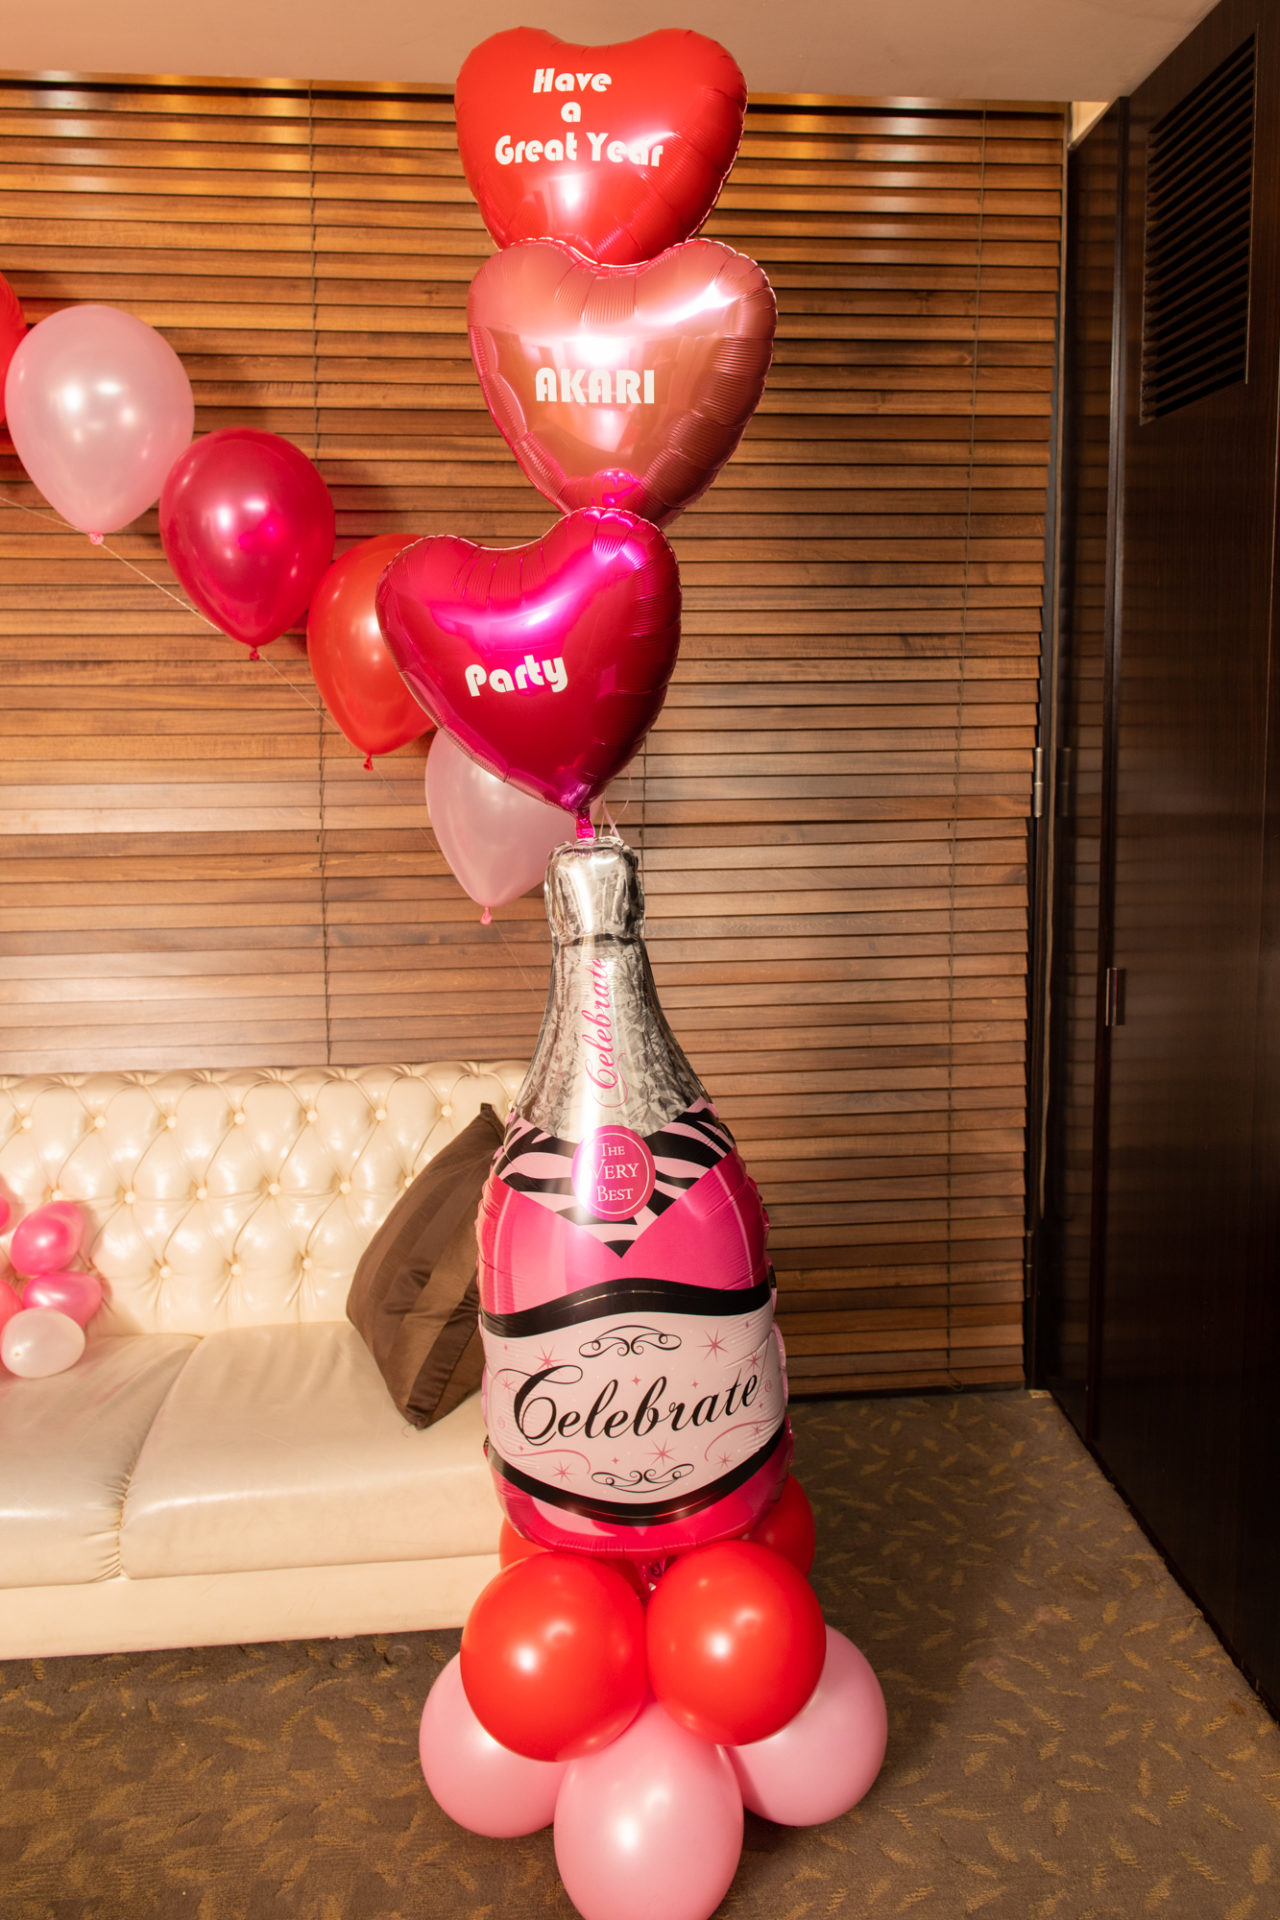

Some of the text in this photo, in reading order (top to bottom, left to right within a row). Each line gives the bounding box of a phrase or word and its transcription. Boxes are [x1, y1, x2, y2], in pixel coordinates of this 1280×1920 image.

[532, 68, 612, 93] Have
[560, 101, 582, 122] a
[494, 132, 664, 167] Great Year
[535, 367, 655, 404] AKARI
[464, 654, 569, 697] Party
[581, 958, 628, 1108] Celebrate
[600, 1142, 625, 1157] THE
[597, 1185, 634, 1202] BEST
[497, 1364, 762, 1446] Celebrate
